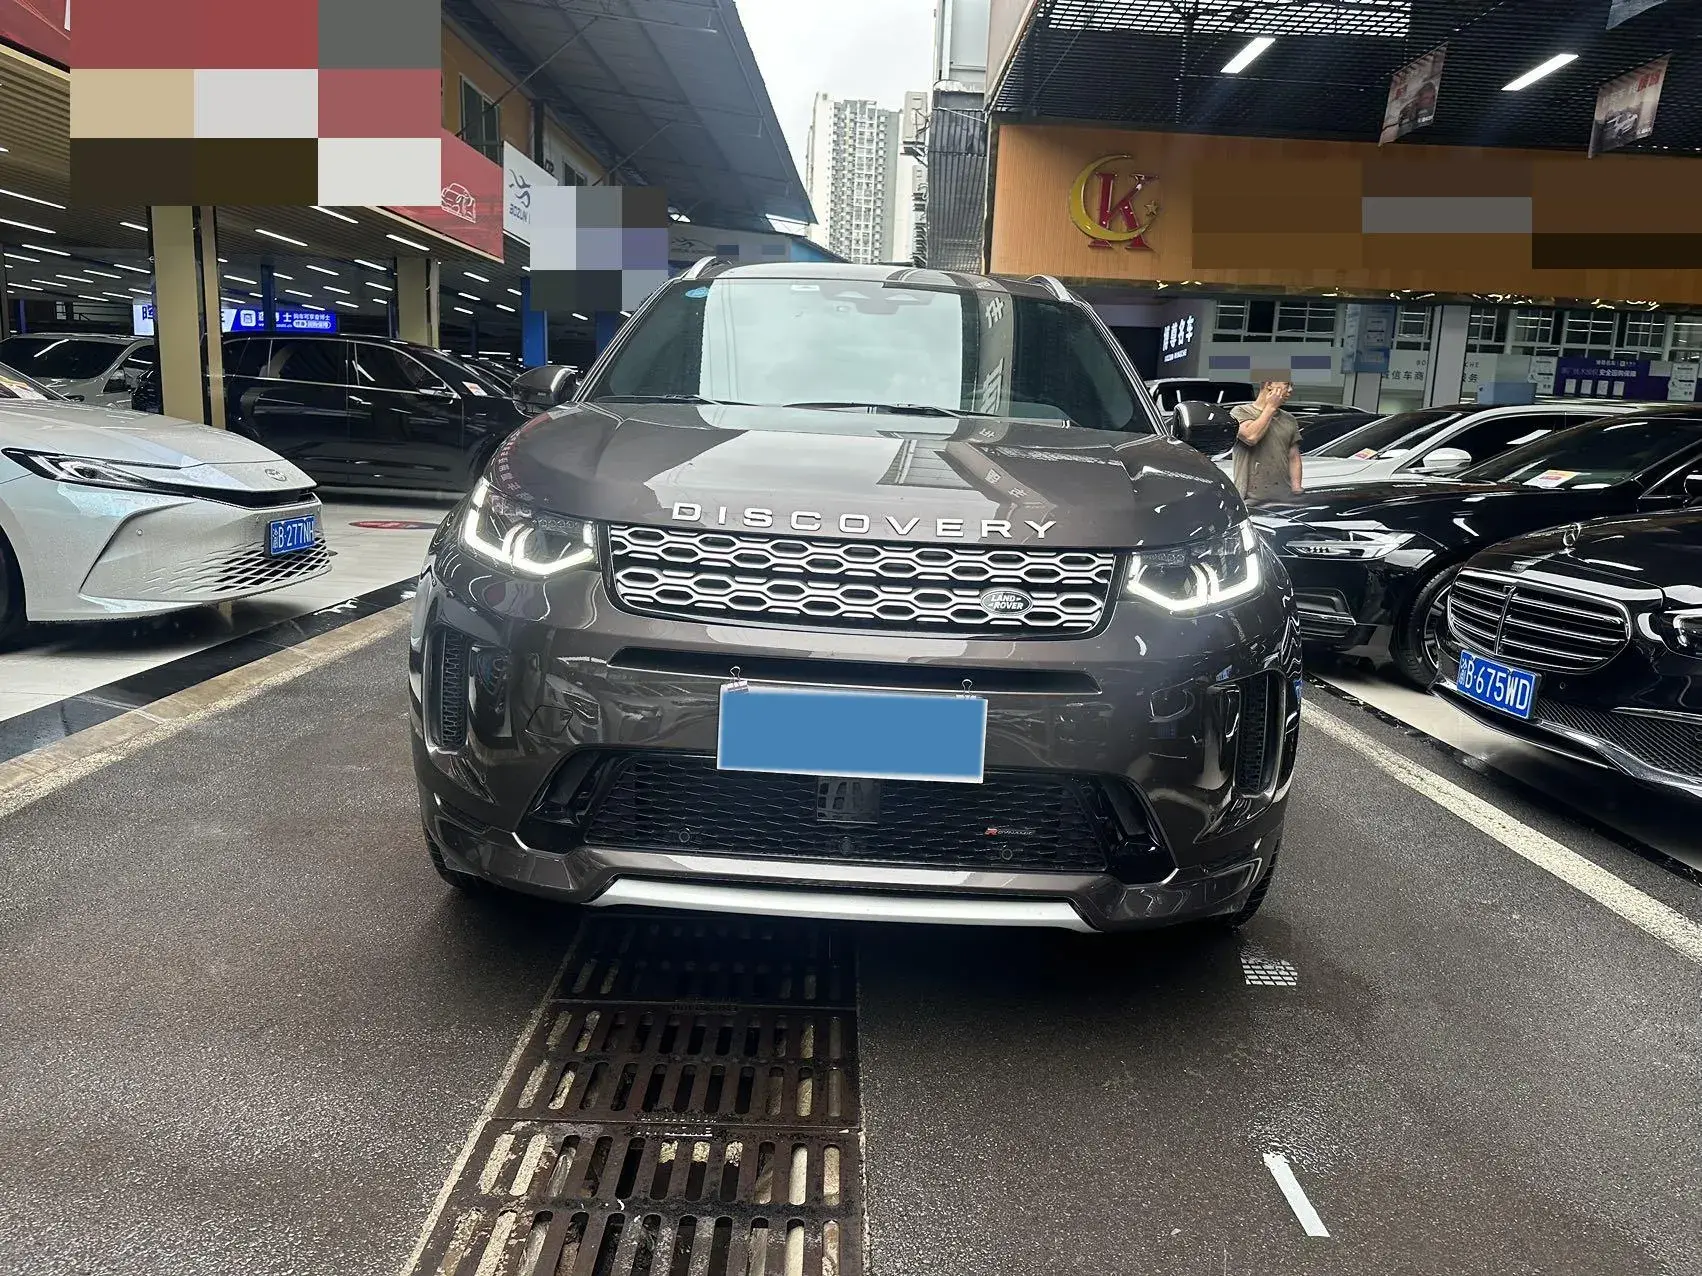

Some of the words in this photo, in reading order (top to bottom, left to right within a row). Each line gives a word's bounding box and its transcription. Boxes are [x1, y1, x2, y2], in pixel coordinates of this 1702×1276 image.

[671, 501, 1057, 539] DISCOVERY
[991, 594, 1016, 602] LAND
[993, 601, 1024, 610] ROVER
